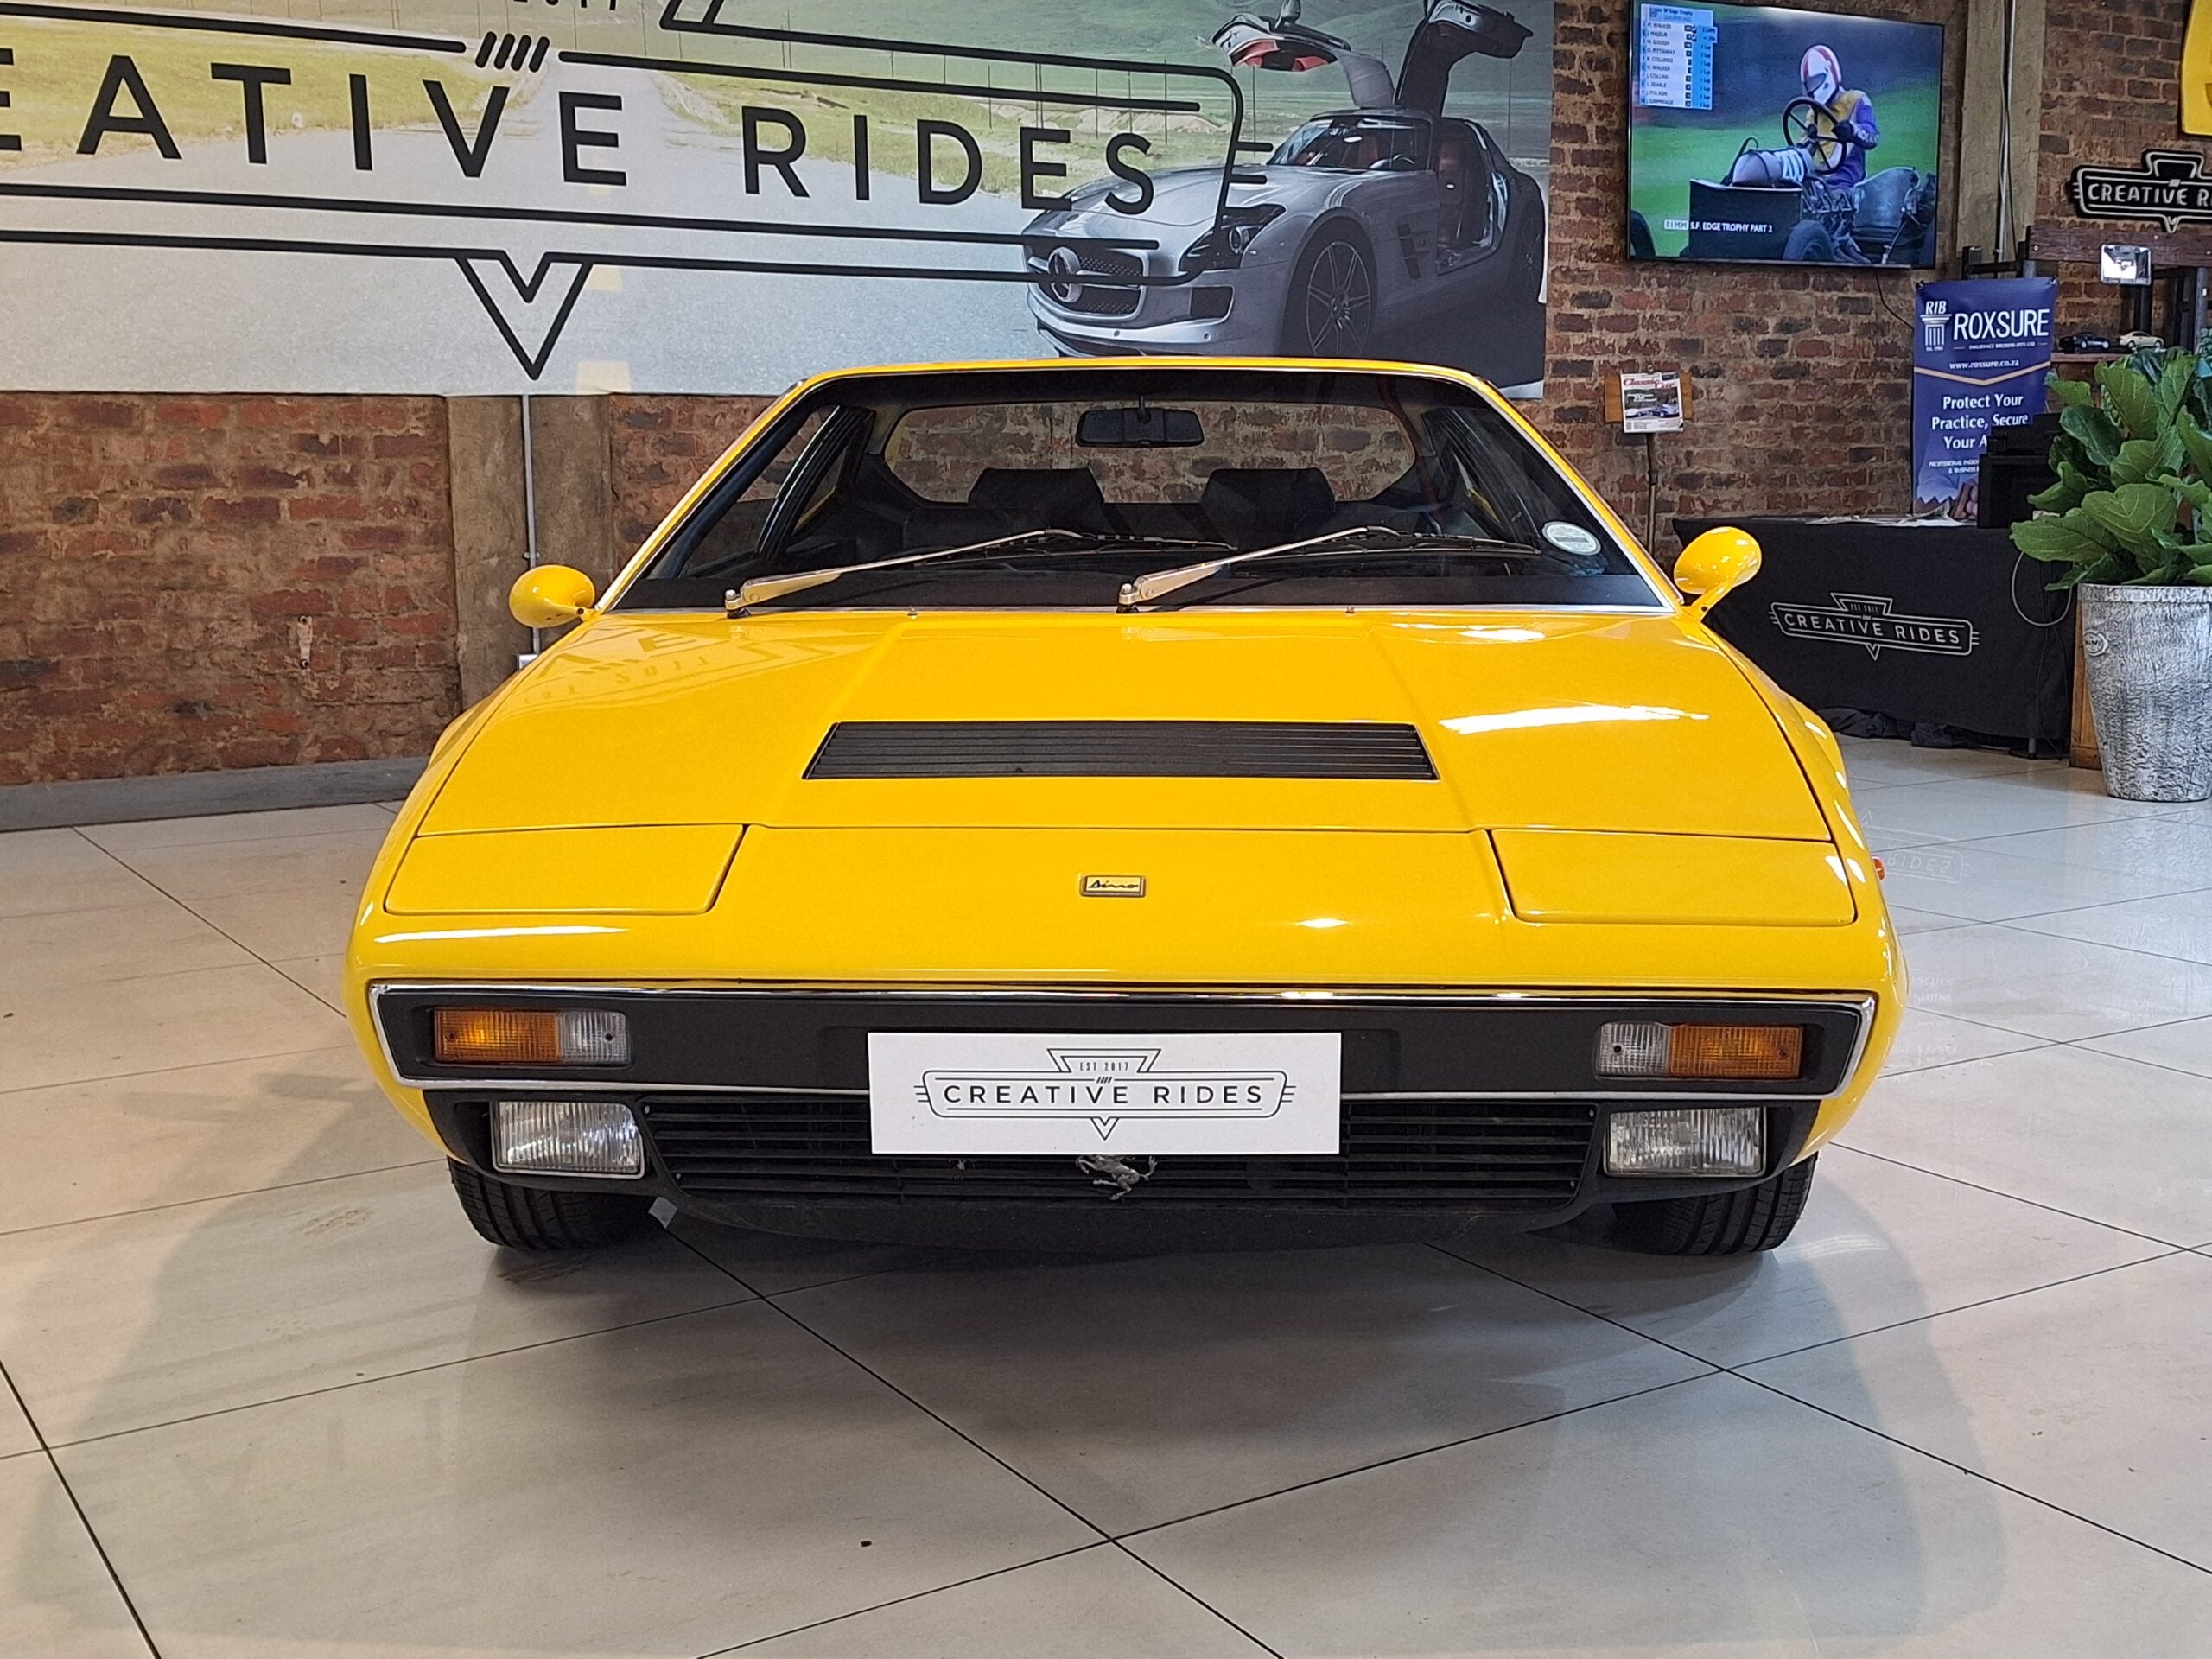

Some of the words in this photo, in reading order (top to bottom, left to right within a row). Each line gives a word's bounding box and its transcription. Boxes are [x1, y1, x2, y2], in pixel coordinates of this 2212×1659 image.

[741, 105, 1154, 215] RIDES
[2088, 183, 2188, 206] CREATIVE
[1702, 221, 1721, 231] EDGE
[1721, 222, 1750, 232] TROPHY
[1750, 223, 1768, 232] PART
[1926, 301, 1947, 315] RIB
[1954, 309, 2050, 340] ROXSURE
[1949, 359, 2019, 370] www.roxsure.co.za
[1943, 395, 1991, 410] Protect
[1994, 393, 2024, 407] Your
[1932, 415, 1989, 430] Practice,
[1993, 413, 2029, 427] Secure
[1944, 436, 1976, 449] Your
[1784, 613, 1883, 636] CREATIVE
[1895, 625, 1959, 644] RIDES
[1088, 879, 1140, 888] Dino
[1079, 1061, 1096, 1071] EST
[1104, 1061, 1128, 1071] 2017
[944, 1085, 1128, 1104] CREATIVE
[1154, 1085, 1262, 1104] RIDES
